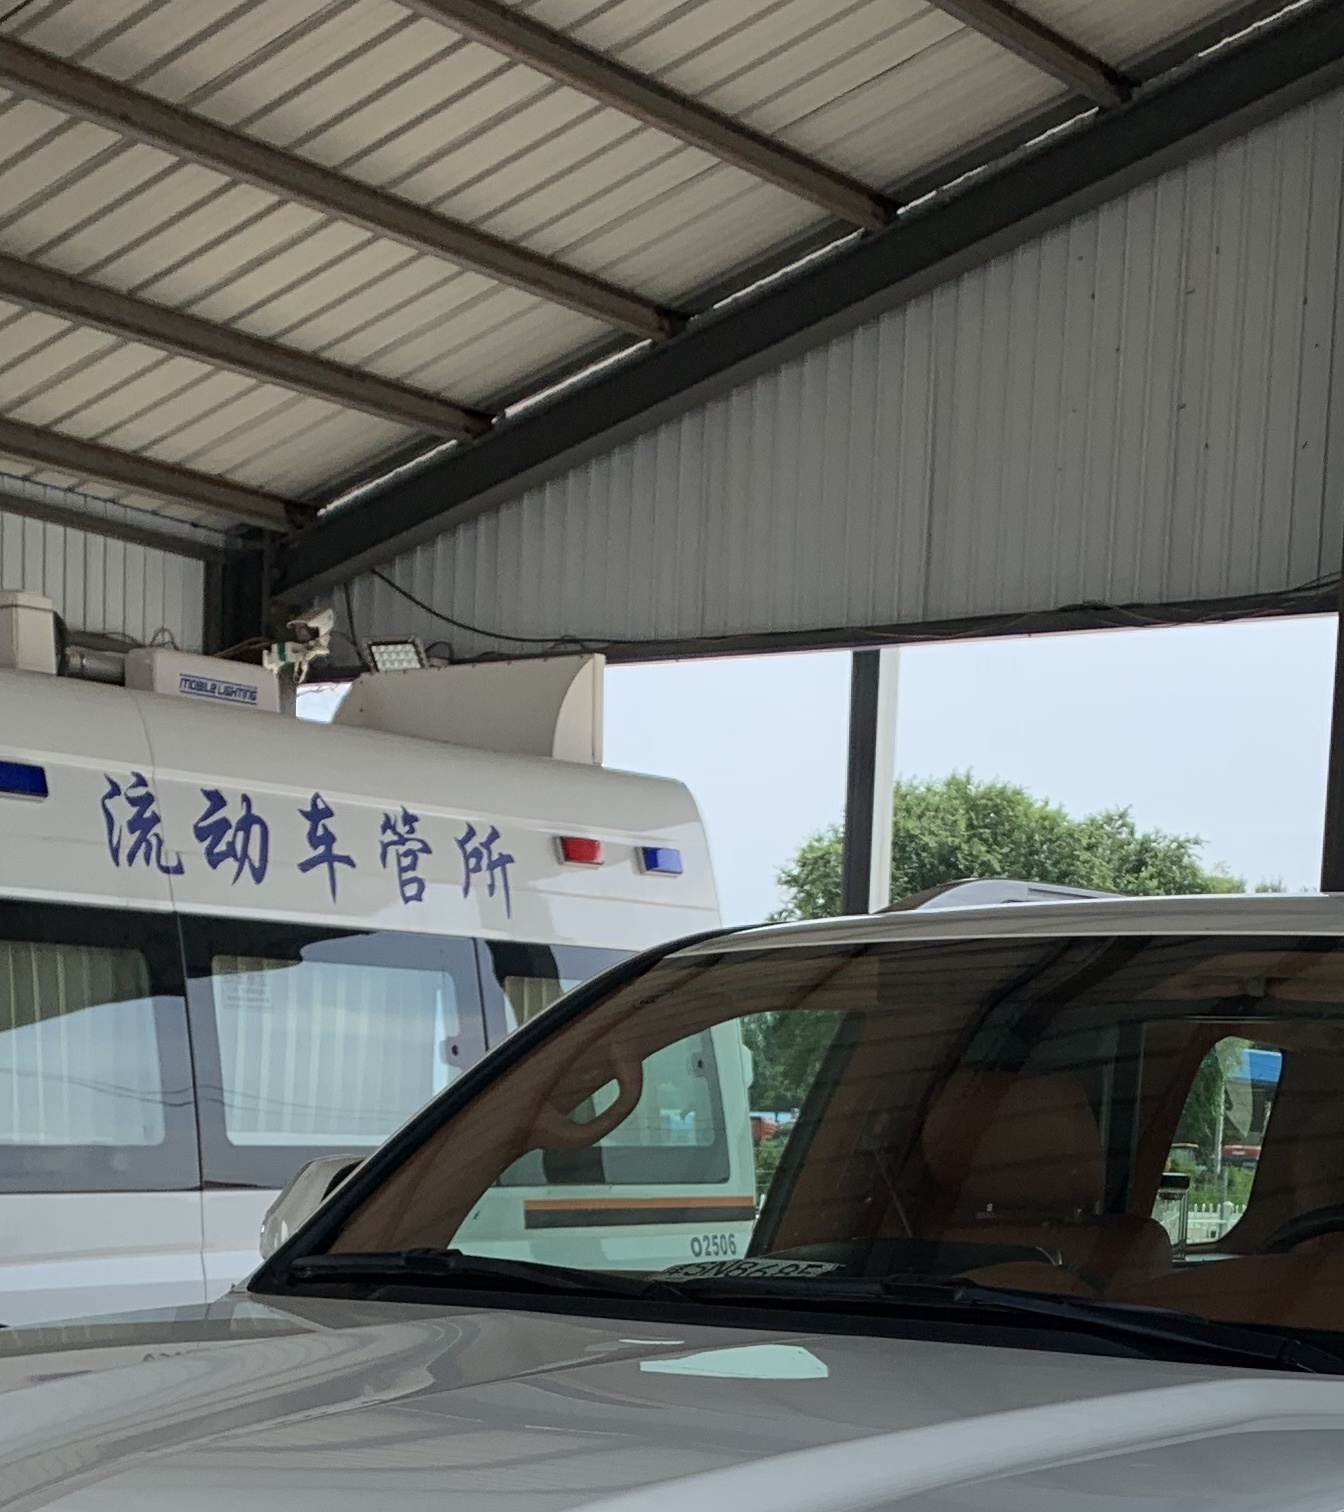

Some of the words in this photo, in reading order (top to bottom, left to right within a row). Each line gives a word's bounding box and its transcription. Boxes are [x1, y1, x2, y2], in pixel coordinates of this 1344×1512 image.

[100, 771, 515, 920] 流动车管所
